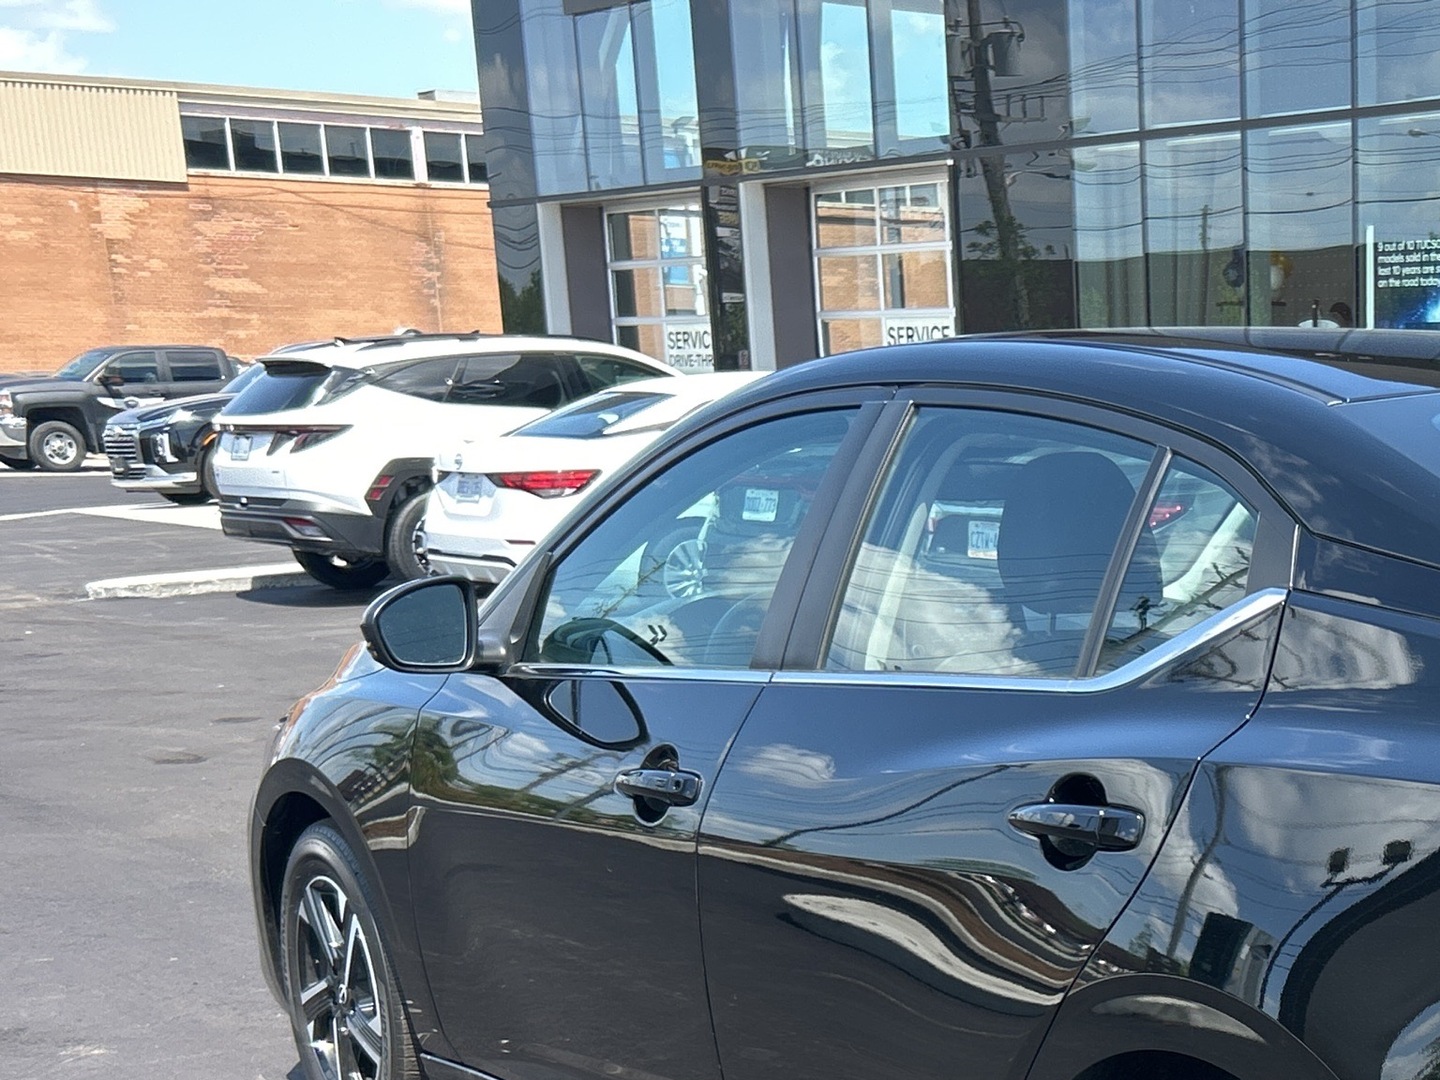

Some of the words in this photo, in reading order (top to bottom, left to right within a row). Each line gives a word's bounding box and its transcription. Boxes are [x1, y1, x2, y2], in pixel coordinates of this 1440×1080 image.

[1377, 242, 1383, 252] 9
[1384, 242, 1396, 251] out
[1398, 241, 1405, 251] of
[1406, 240, 1415, 250] 10
[1378, 252, 1405, 263] models
[1405, 252, 1421, 262] sold
[1422, 251, 1429, 262] in
[1378, 266, 1391, 276] last
[1392, 265, 1401, 275] 10
[1402, 266, 1421, 277] years
[1422, 266, 1435, 274] are
[1377, 280, 1388, 288] on
[1389, 277, 1401, 287] the
[1402, 277, 1419, 287] road
[667, 330, 711, 350] SERVIC
[888, 325, 950, 346] SERVICE
[669, 354, 715, 368] DRIVE-THR
